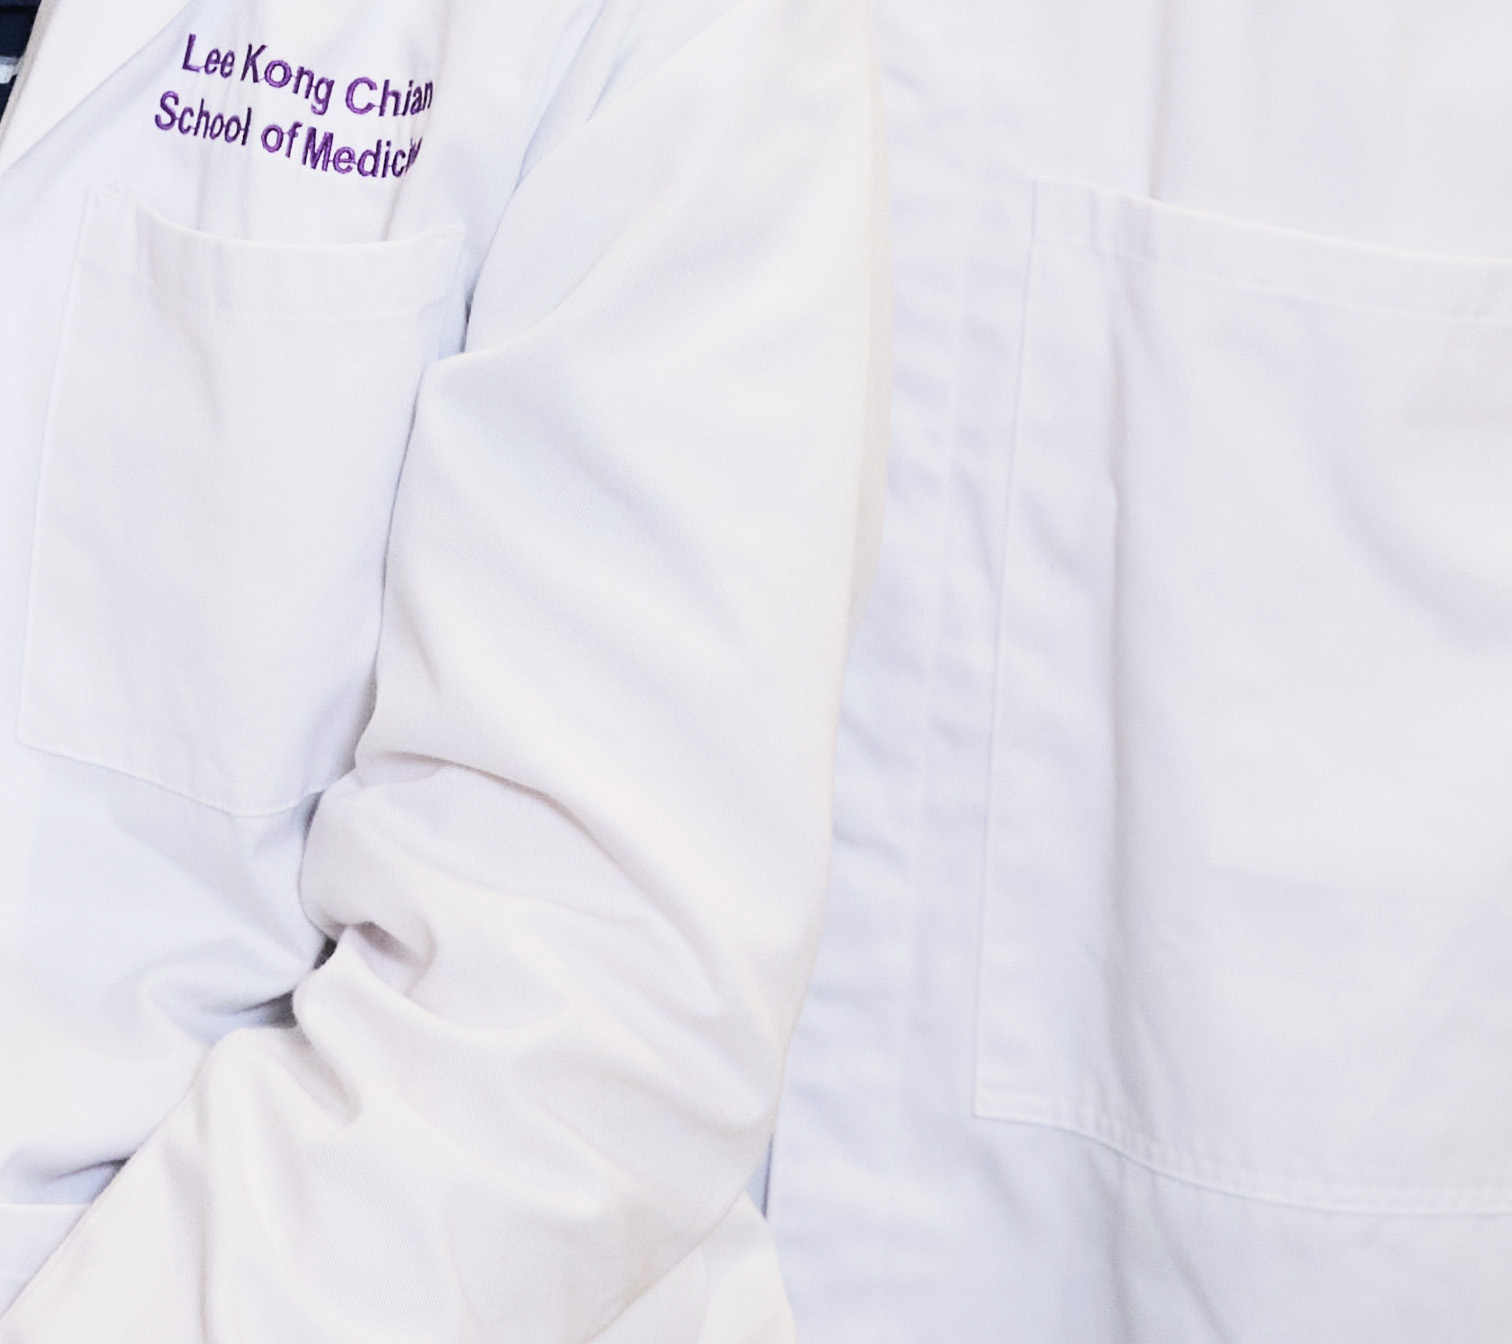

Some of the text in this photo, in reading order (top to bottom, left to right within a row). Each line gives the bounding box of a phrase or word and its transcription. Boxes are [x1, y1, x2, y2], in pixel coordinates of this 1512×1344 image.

[181, 33, 236, 80] Lee
[240, 43, 335, 116] Kong
[154, 90, 252, 146] School
[261, 120, 304, 159] of
